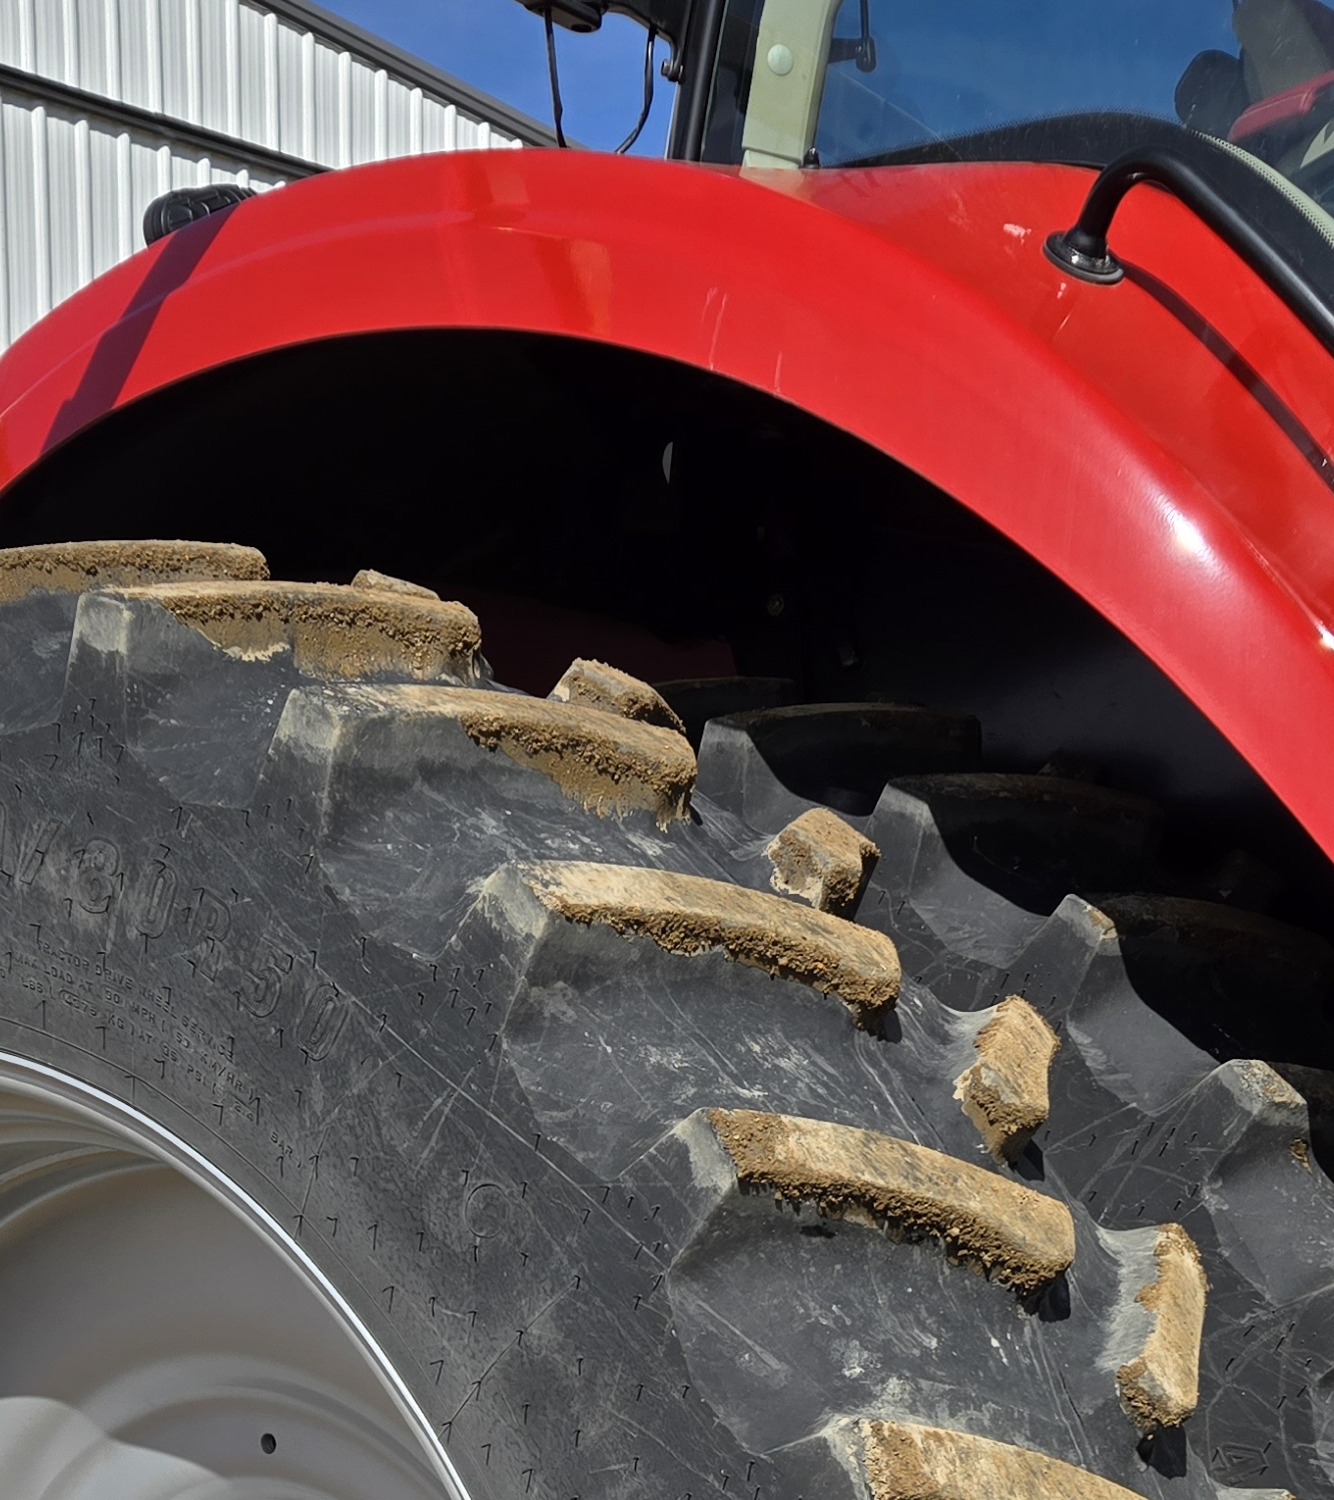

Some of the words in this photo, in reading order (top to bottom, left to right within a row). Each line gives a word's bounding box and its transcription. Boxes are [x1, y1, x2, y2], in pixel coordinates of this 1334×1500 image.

[37, 938, 90, 973] TRACTOR
[95, 961, 133, 994] DRIVE
[181, 1012, 236, 1064] SERVICE
[43, 961, 74, 986] LOAD
